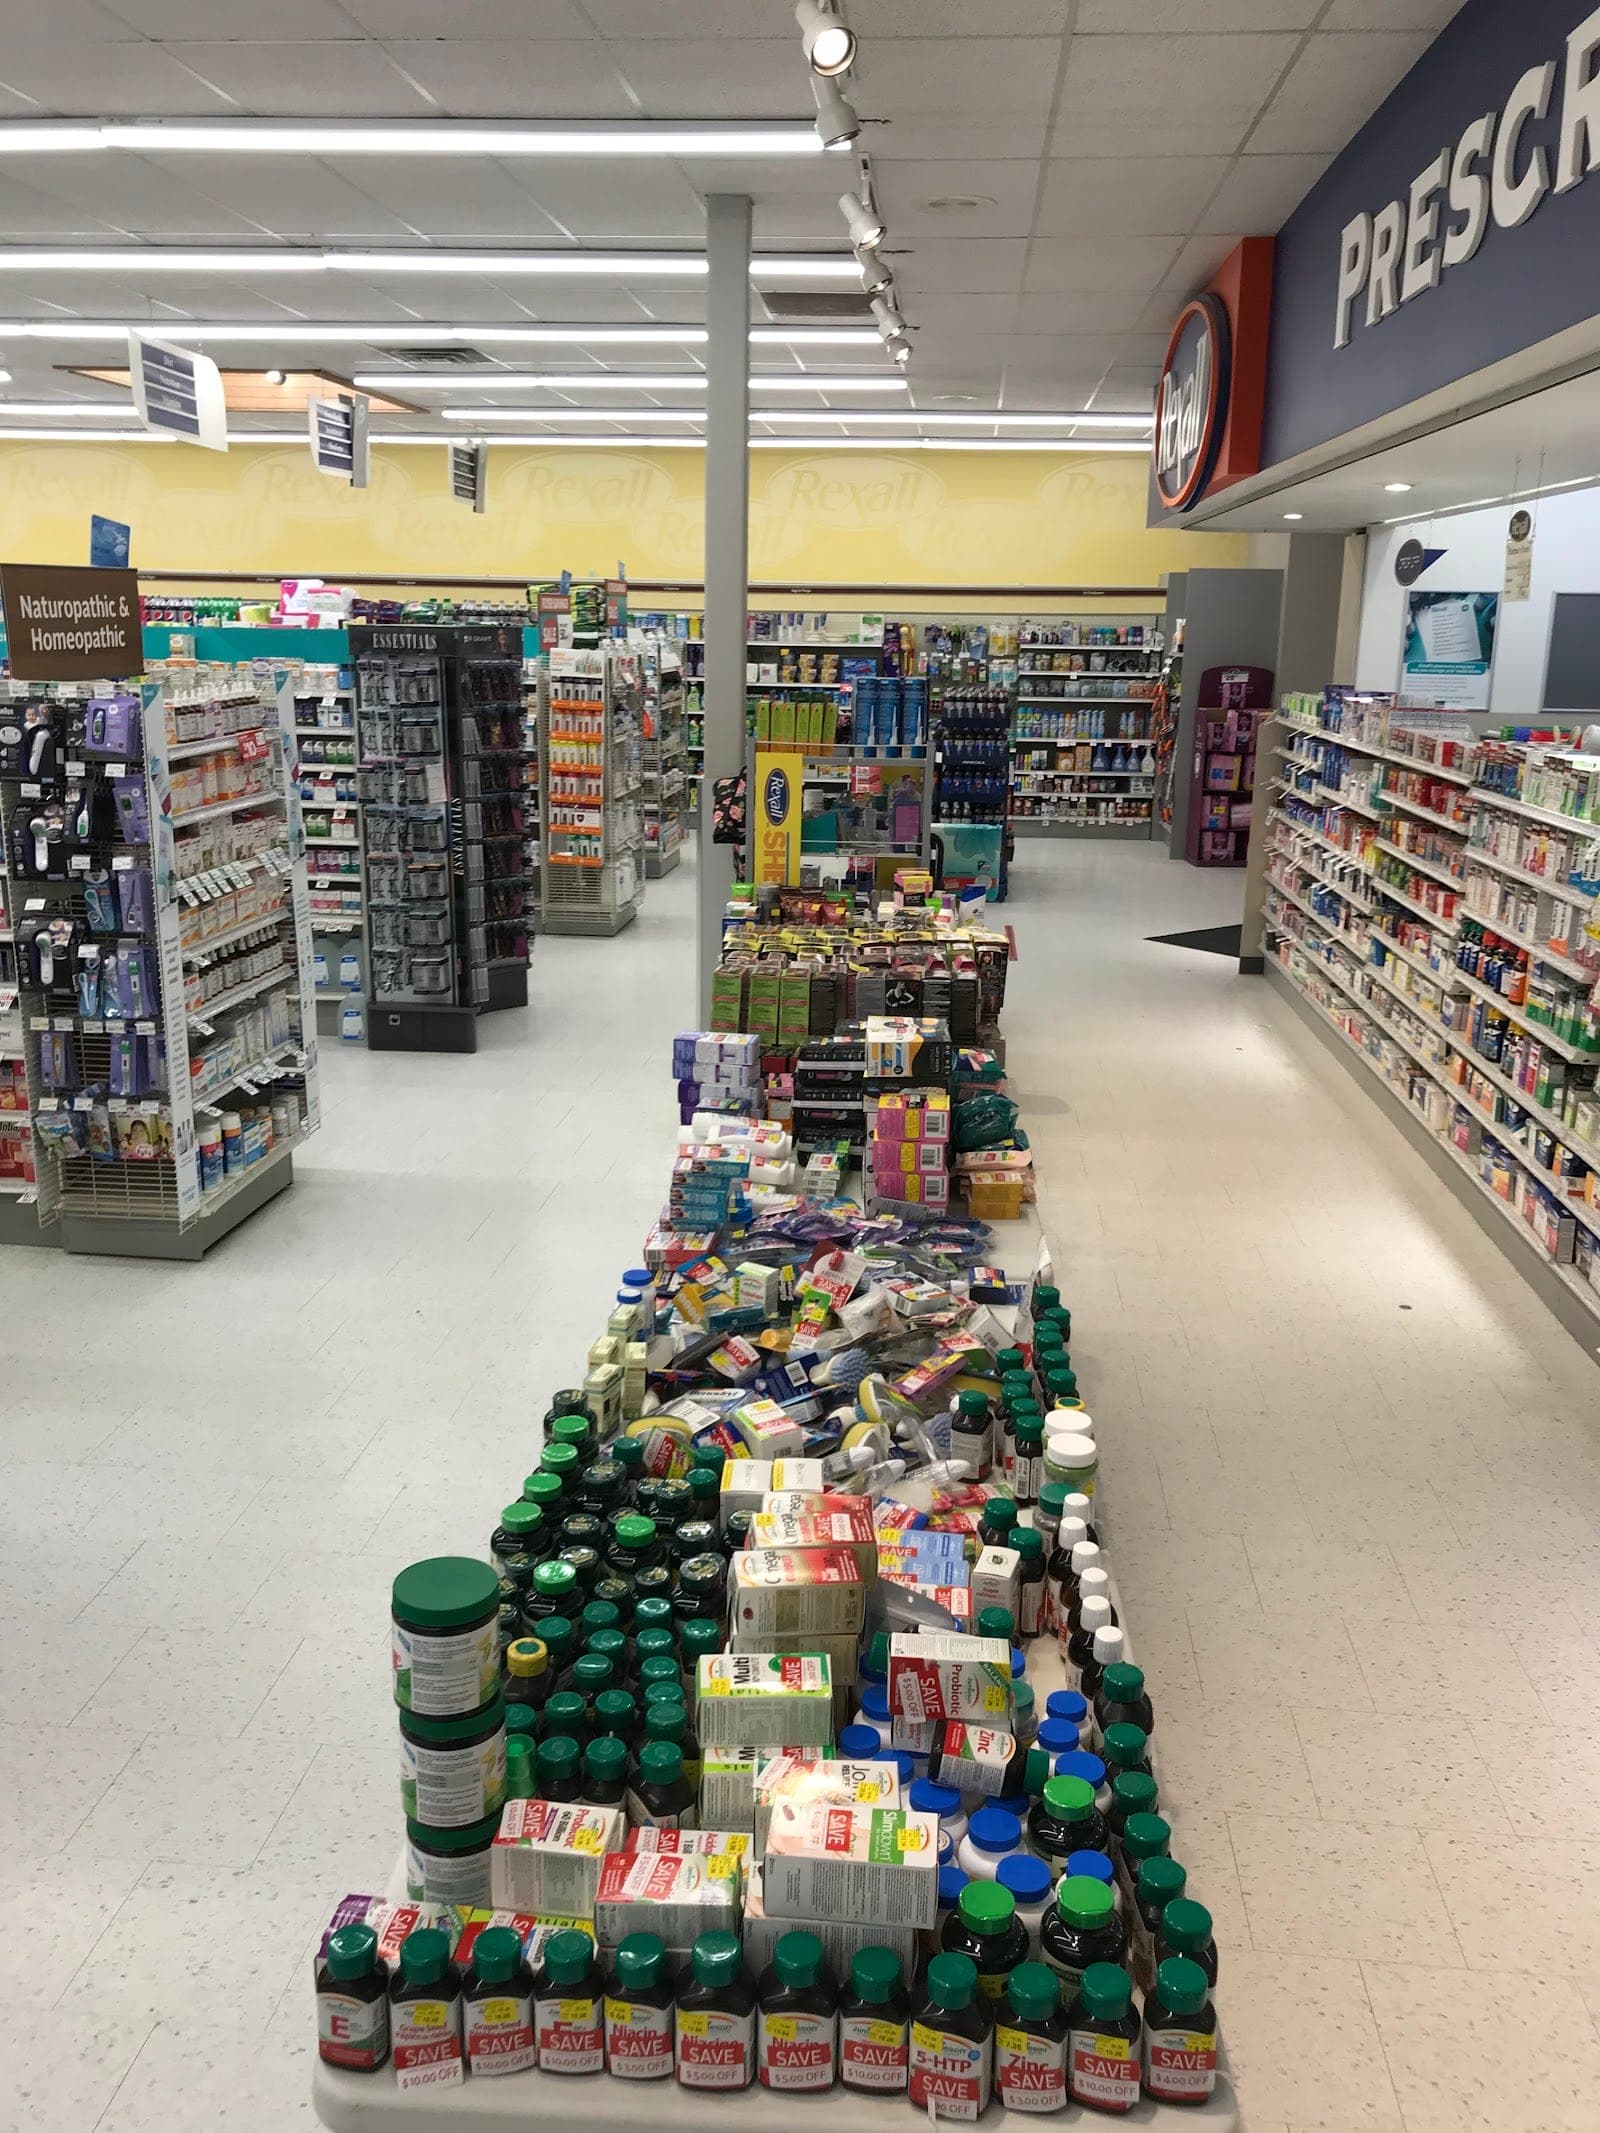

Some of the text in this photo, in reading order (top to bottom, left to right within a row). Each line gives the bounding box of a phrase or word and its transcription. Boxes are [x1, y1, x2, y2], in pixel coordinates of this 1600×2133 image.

[1158, 330, 1208, 488] Rexall
[523, 465, 655, 510] Rexall
[790, 469, 923, 514] Rexall
[20, 594, 130, 624] Naturopathic &
[31, 624, 126, 654] Homeopathic
[373, 633, 437, 650] ESSENTIALS
[768, 777, 784, 818] Rexall
[800, 1324, 818, 1337] SAVE
[655, 1440, 673, 1469] SAVE
[818, 1516, 831, 1537] SAVE
[882, 1547, 913, 1556] SAVE
[734, 1657, 749, 1684] Multi
[785, 1661, 800, 1687] SAVE
[920, 1677, 940, 1714] SAVE
[950, 1664, 963, 1715] Probiotic
[909, 1702, 919, 1718] OFF
[978, 1730, 995, 1754] Zinc
[524, 1804, 543, 1834] SAVE
[552, 1821, 569, 1842] Billion
[829, 1815, 846, 1847] SAVE
[880, 1811, 897, 1861] Slimdown
[654, 1861, 675, 1893] SAVE
[385, 1913, 412, 1948] SAVE
[330, 2015, 350, 2040] E
[613, 2023, 657, 2038] Niacin
[479, 2033, 525, 2054] SAVE
[549, 2034, 595, 2051] SAVE
[618, 2038, 663, 2056] SAVE
[405, 2043, 453, 2065] SAVE
[510, 2053, 531, 2065] OFF
[579, 2056, 600, 2067] OFF
[689, 2047, 735, 2064] SAVE
[776, 2049, 822, 2066] SAVE
[853, 2046, 899, 2065] SAVE
[916, 2050, 972, 2073] 5-HTP
[1008, 2053, 1049, 2072] Zinc
[1160, 2051, 1207, 2070] SAVE
[645, 2060, 668, 2072] OFF
[716, 2069, 738, 2081] OFF
[805, 2070, 826, 2081] OFF
[847, 2067, 904, 2081] $10.00 OFF
[1084, 2057, 1131, 2080] SAVE
[402, 2066, 460, 2089] $10.00 OFF
[922, 2075, 968, 2098] SAVE
[1009, 2072, 1056, 2088] SAVE
[1078, 2079, 1136, 2097] $10.00 OFF
[948, 2105, 970, 2115] OFF
